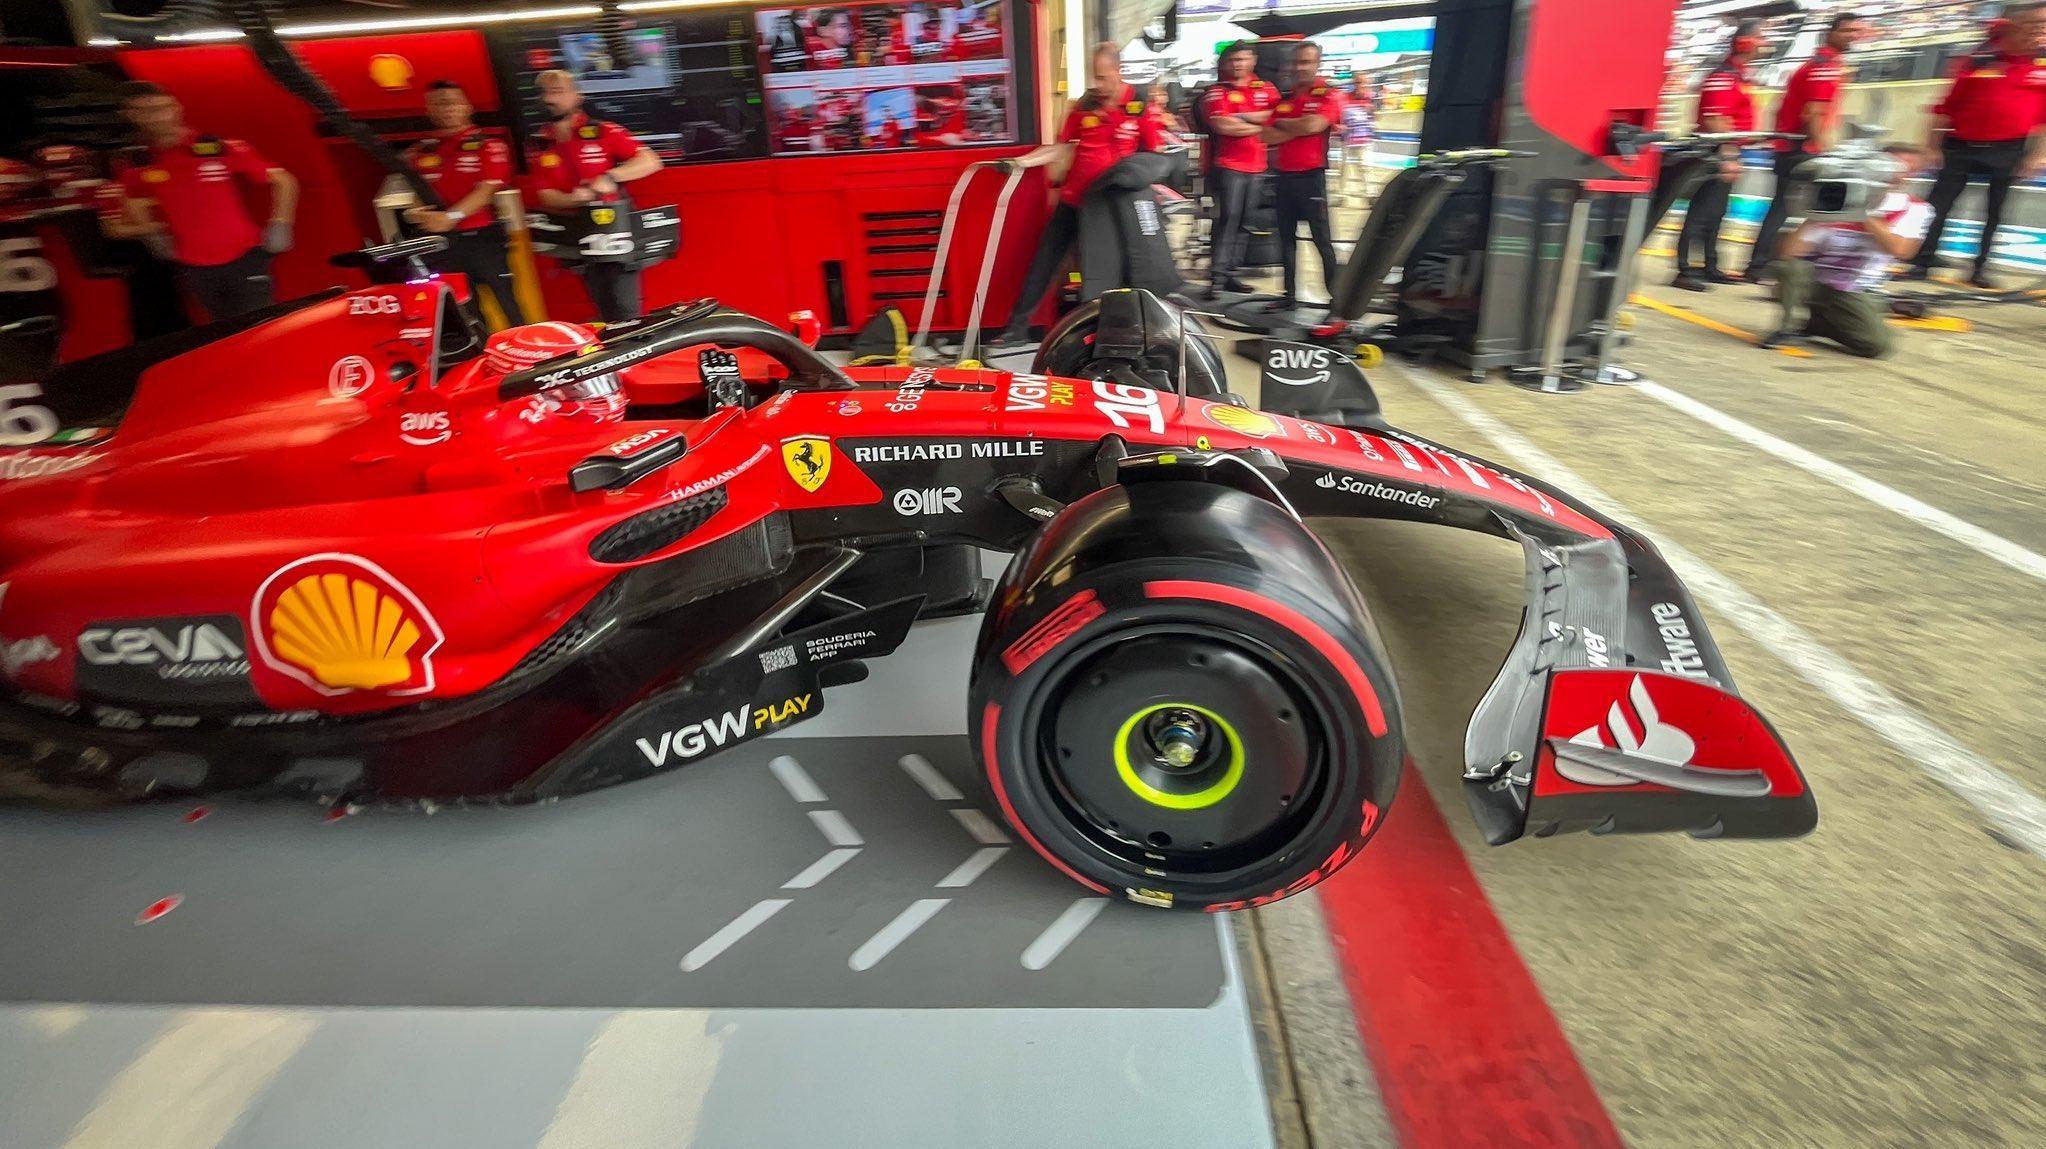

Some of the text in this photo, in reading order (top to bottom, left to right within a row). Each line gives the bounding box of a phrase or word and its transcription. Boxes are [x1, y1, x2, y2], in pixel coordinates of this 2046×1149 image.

[573, 346, 654, 377] TECHNOLOGY
[1268, 349, 1330, 369] aws
[1004, 372, 1049, 412] VGW
[1050, 381, 1074, 406] PLAY
[1091, 376, 1165, 435] 16
[400, 411, 451, 432] aws
[855, 440, 1044, 463] RICHARD MILLE
[670, 469, 735, 500] HARMAN
[1337, 475, 1441, 510] Santander
[806, 630, 877, 648] SCUDERIA
[807, 638, 867, 655] FERRARI
[809, 650, 839, 662] APP
[635, 693, 813, 768] VGW PLAY
